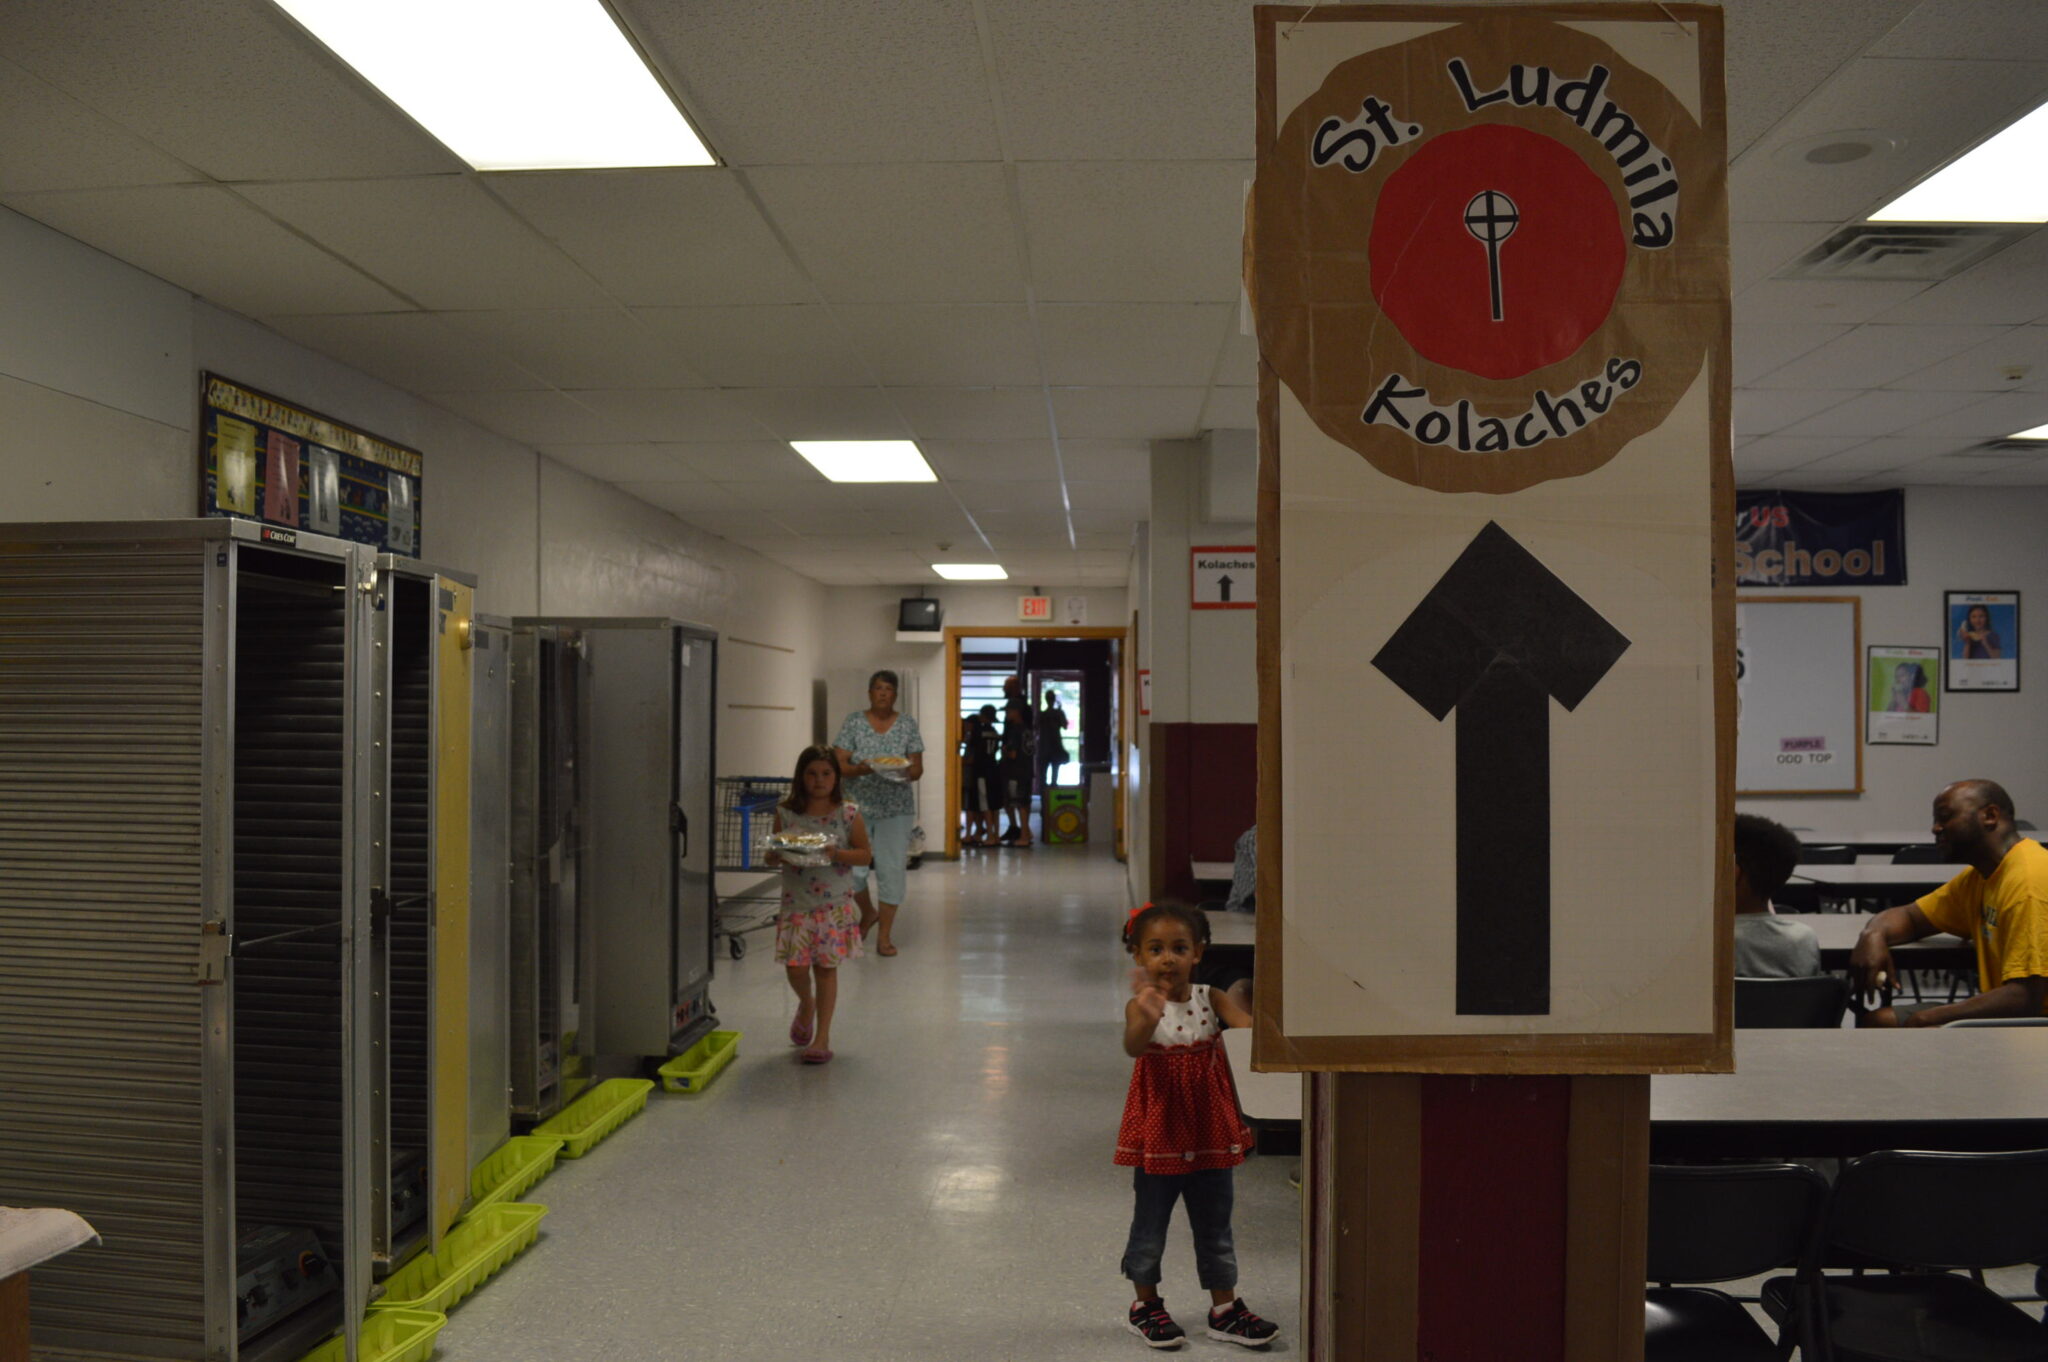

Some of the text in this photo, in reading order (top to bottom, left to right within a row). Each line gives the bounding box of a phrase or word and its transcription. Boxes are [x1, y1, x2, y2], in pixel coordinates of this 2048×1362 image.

[1313, 58, 1680, 249] St. Ludmila
[1363, 357, 1642, 452] Kolaches
[1198, 560, 1255, 570] Kolaches
[1736, 540, 1885, 577] School
[1023, 598, 1047, 616] EXIT
[1809, 753, 1832, 763] TOP
